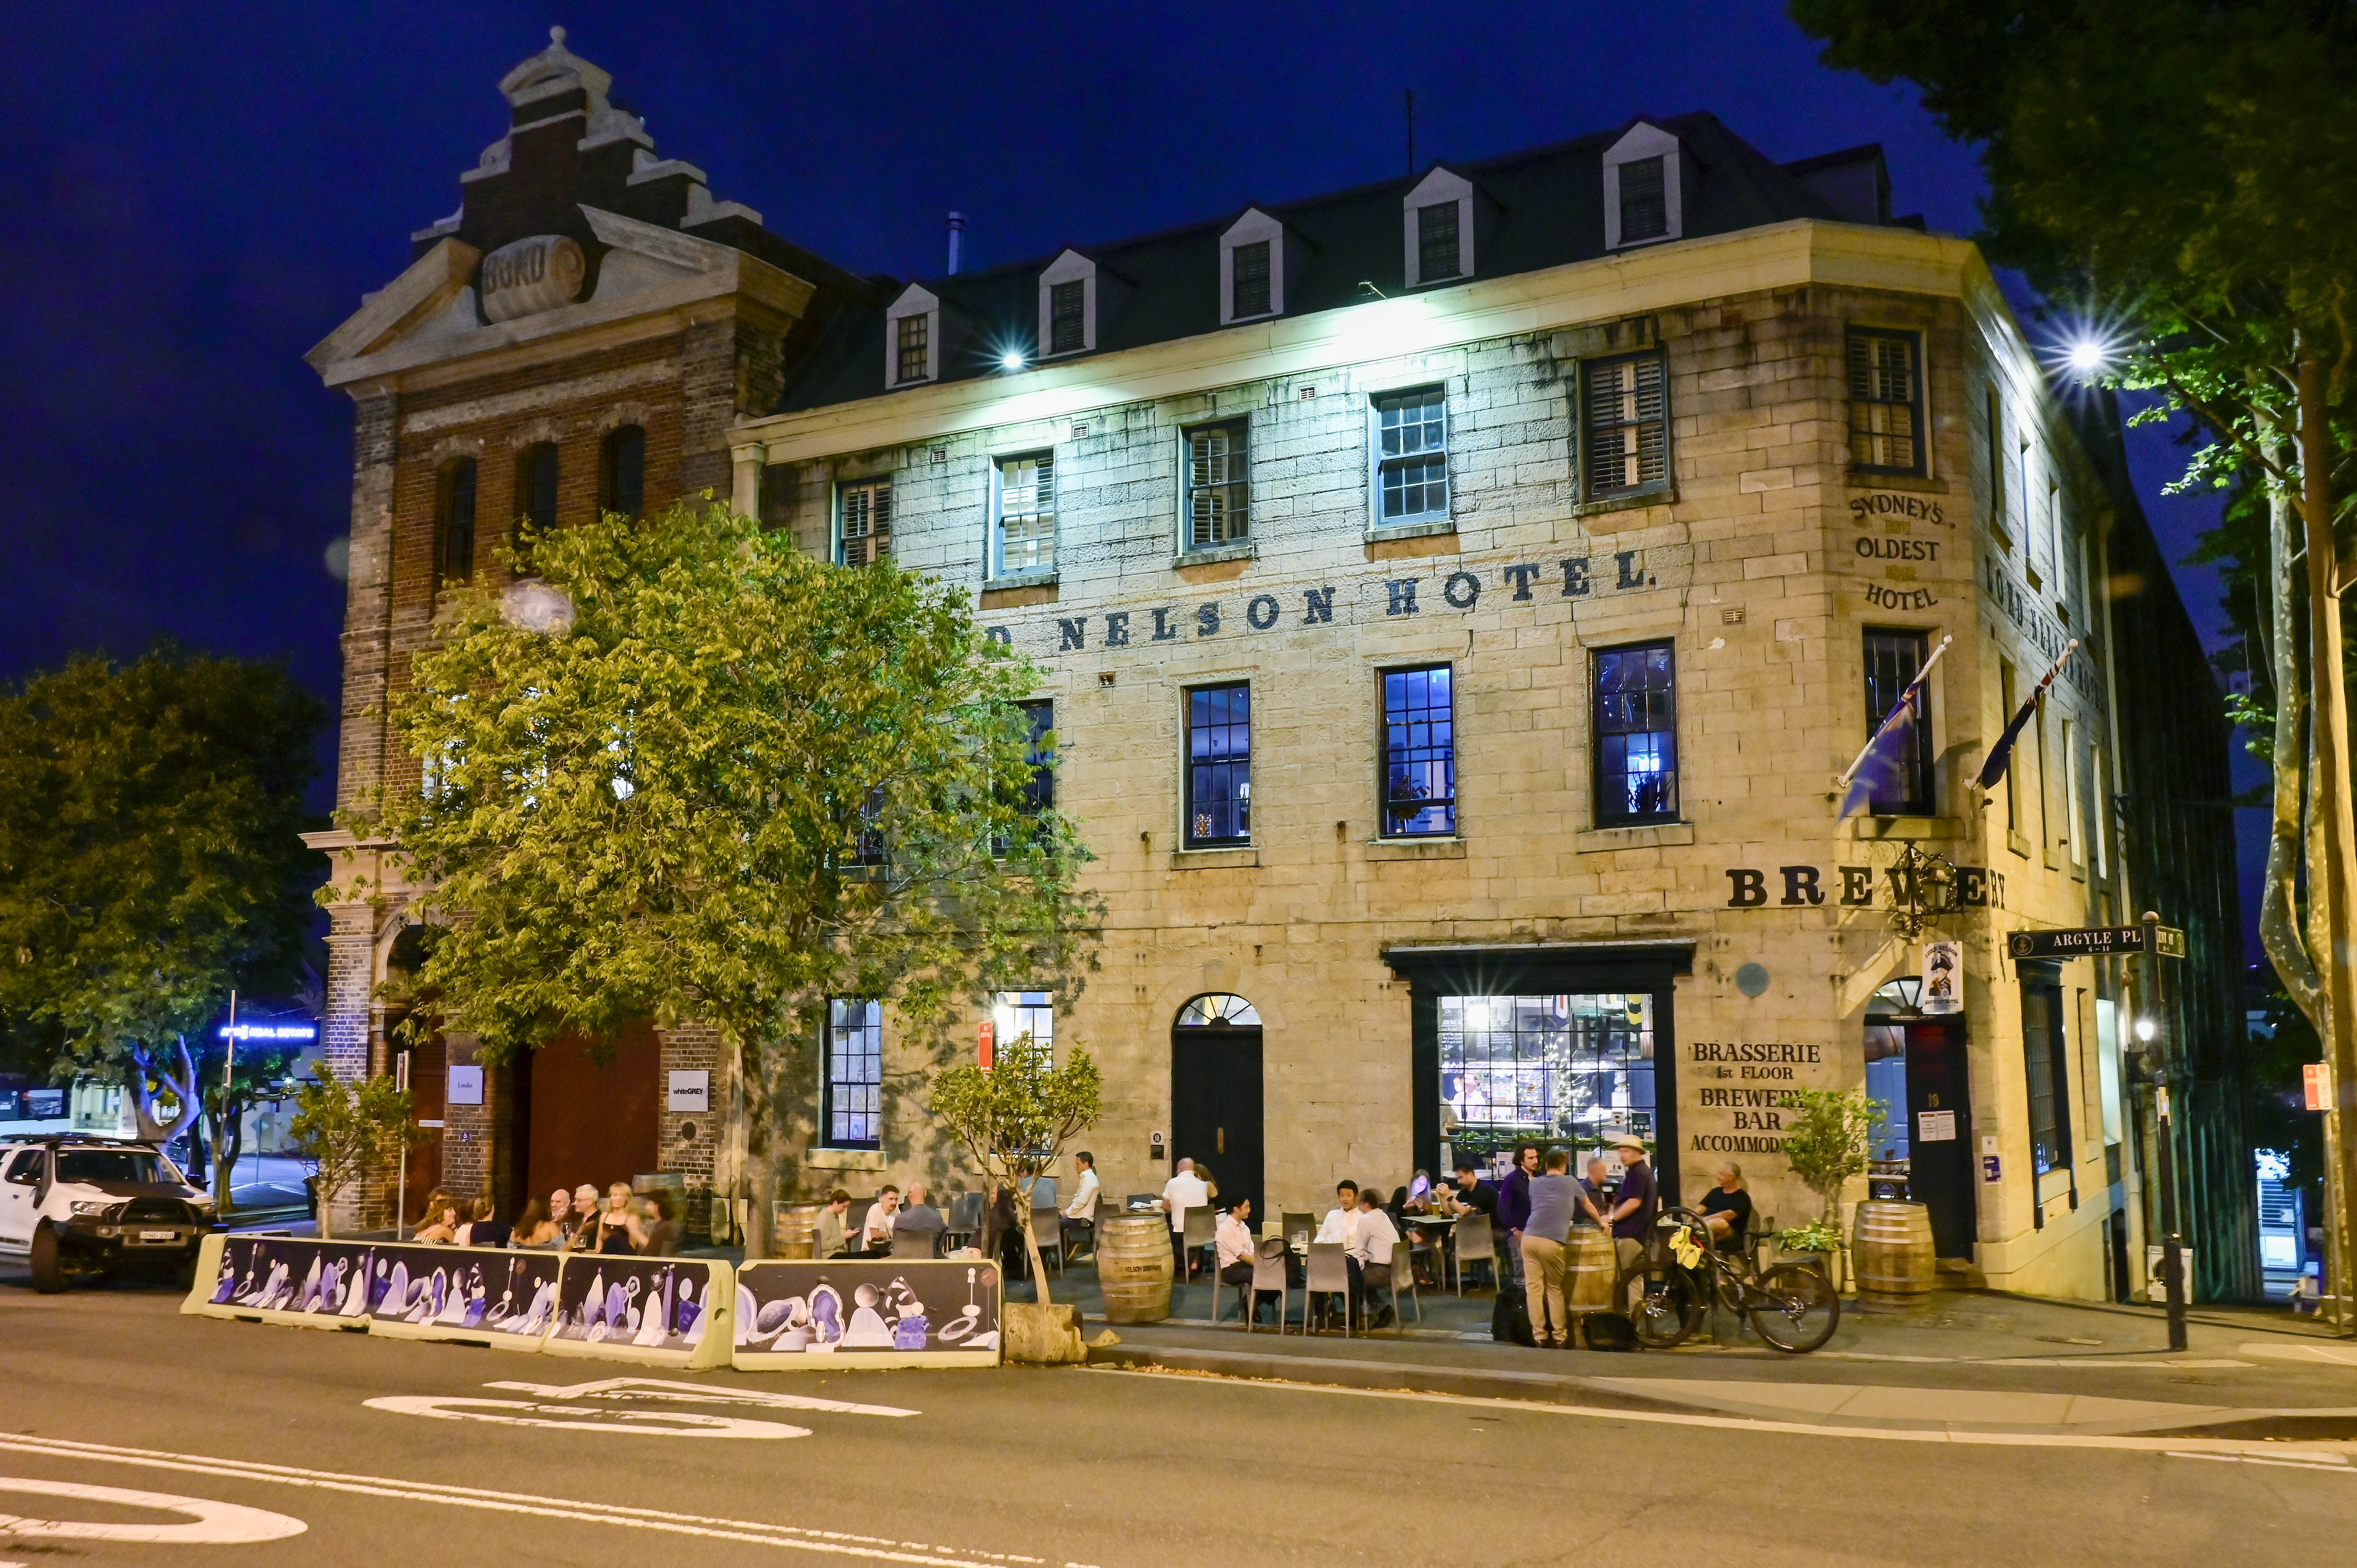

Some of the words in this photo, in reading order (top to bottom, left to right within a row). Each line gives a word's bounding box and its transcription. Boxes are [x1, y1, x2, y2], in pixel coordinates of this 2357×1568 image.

[1850, 494, 1944, 524] SYDNEY'S
[1855, 537, 1940, 561] OLDEST
[1864, 583, 1939, 611] HOTEL
[1058, 586, 1336, 652] NELSON
[1725, 866, 2005, 910] BREWERY
[2053, 932, 2111, 946] ARGYLE
[2122, 930, 2141, 943] PL
[1693, 1043, 1820, 1063] BRASSERIE
[1741, 1066, 1794, 1079] FLOOR
[1733, 1112, 1782, 1130] BAR
